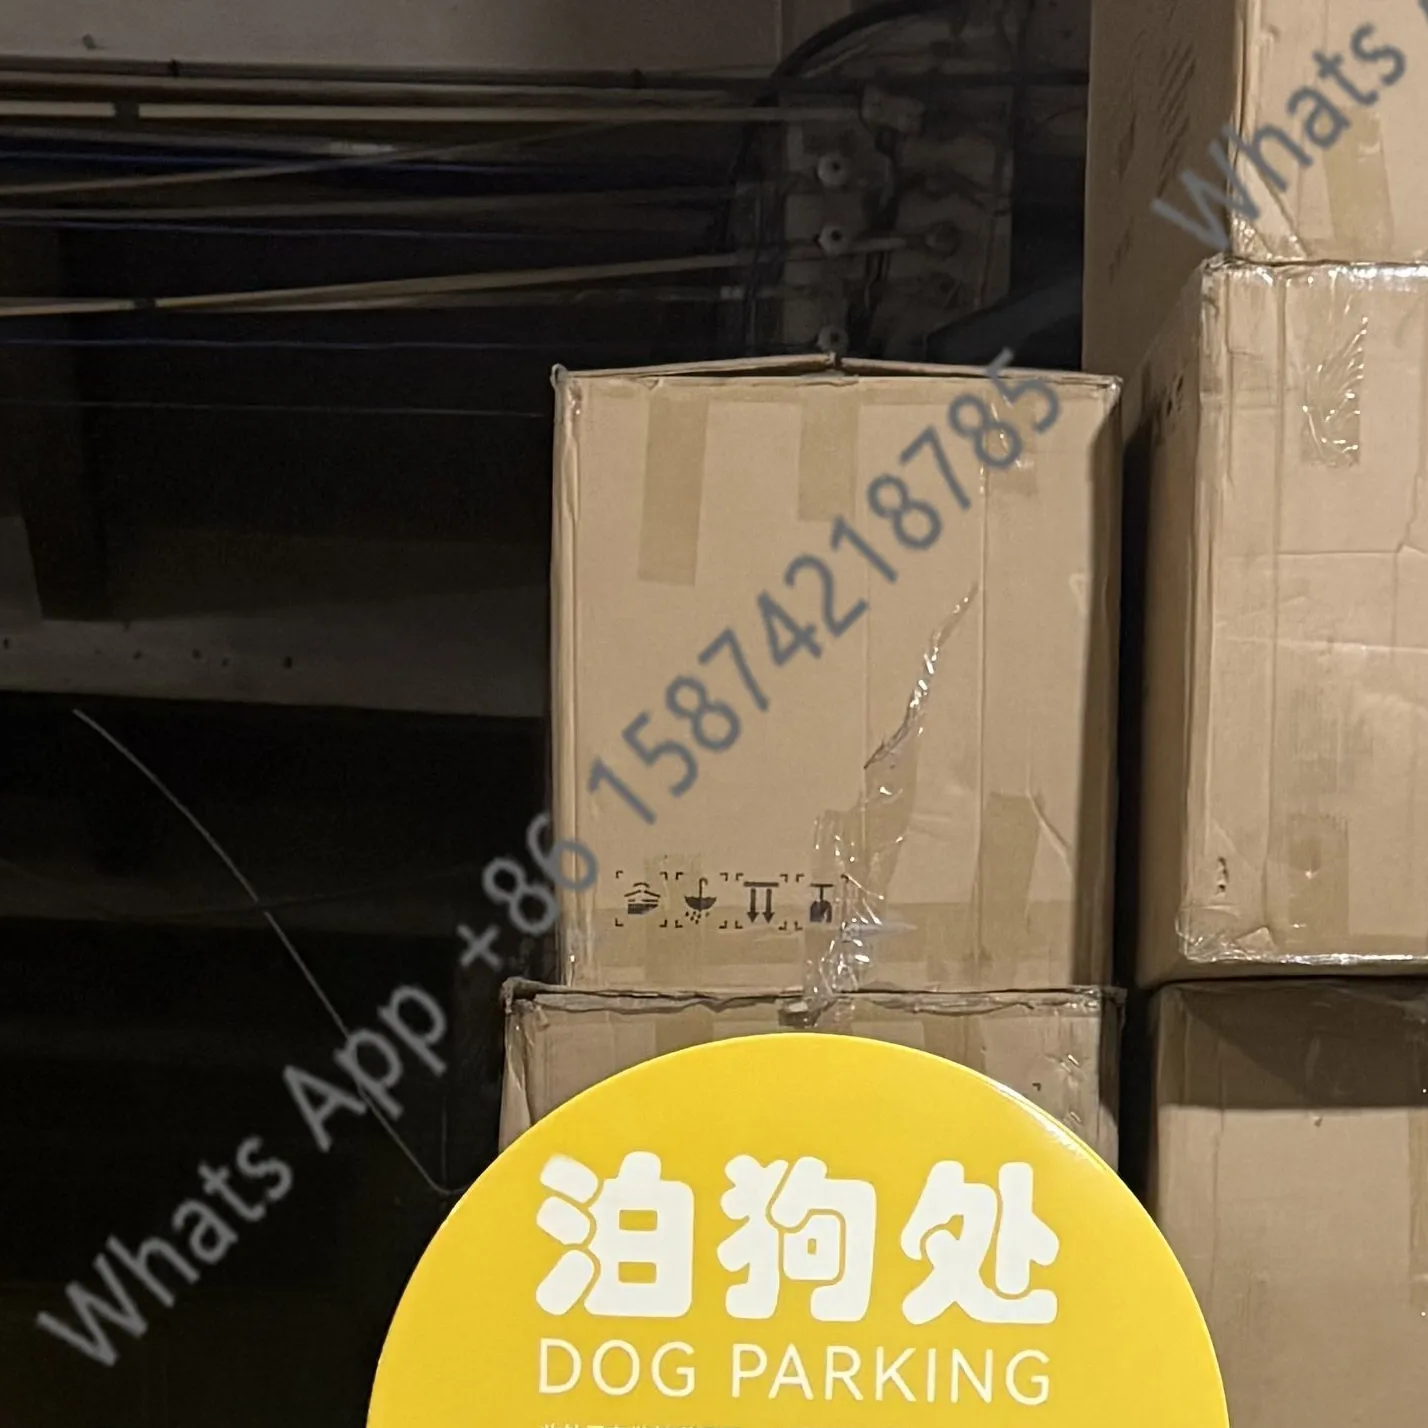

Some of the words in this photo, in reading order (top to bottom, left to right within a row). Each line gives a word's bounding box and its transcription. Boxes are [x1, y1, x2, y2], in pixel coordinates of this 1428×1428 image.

[534, 1151, 1060, 1325] 泊狗处
[538, 1338, 696, 1398] DOG
[731, 1343, 1050, 1405] PARKING
